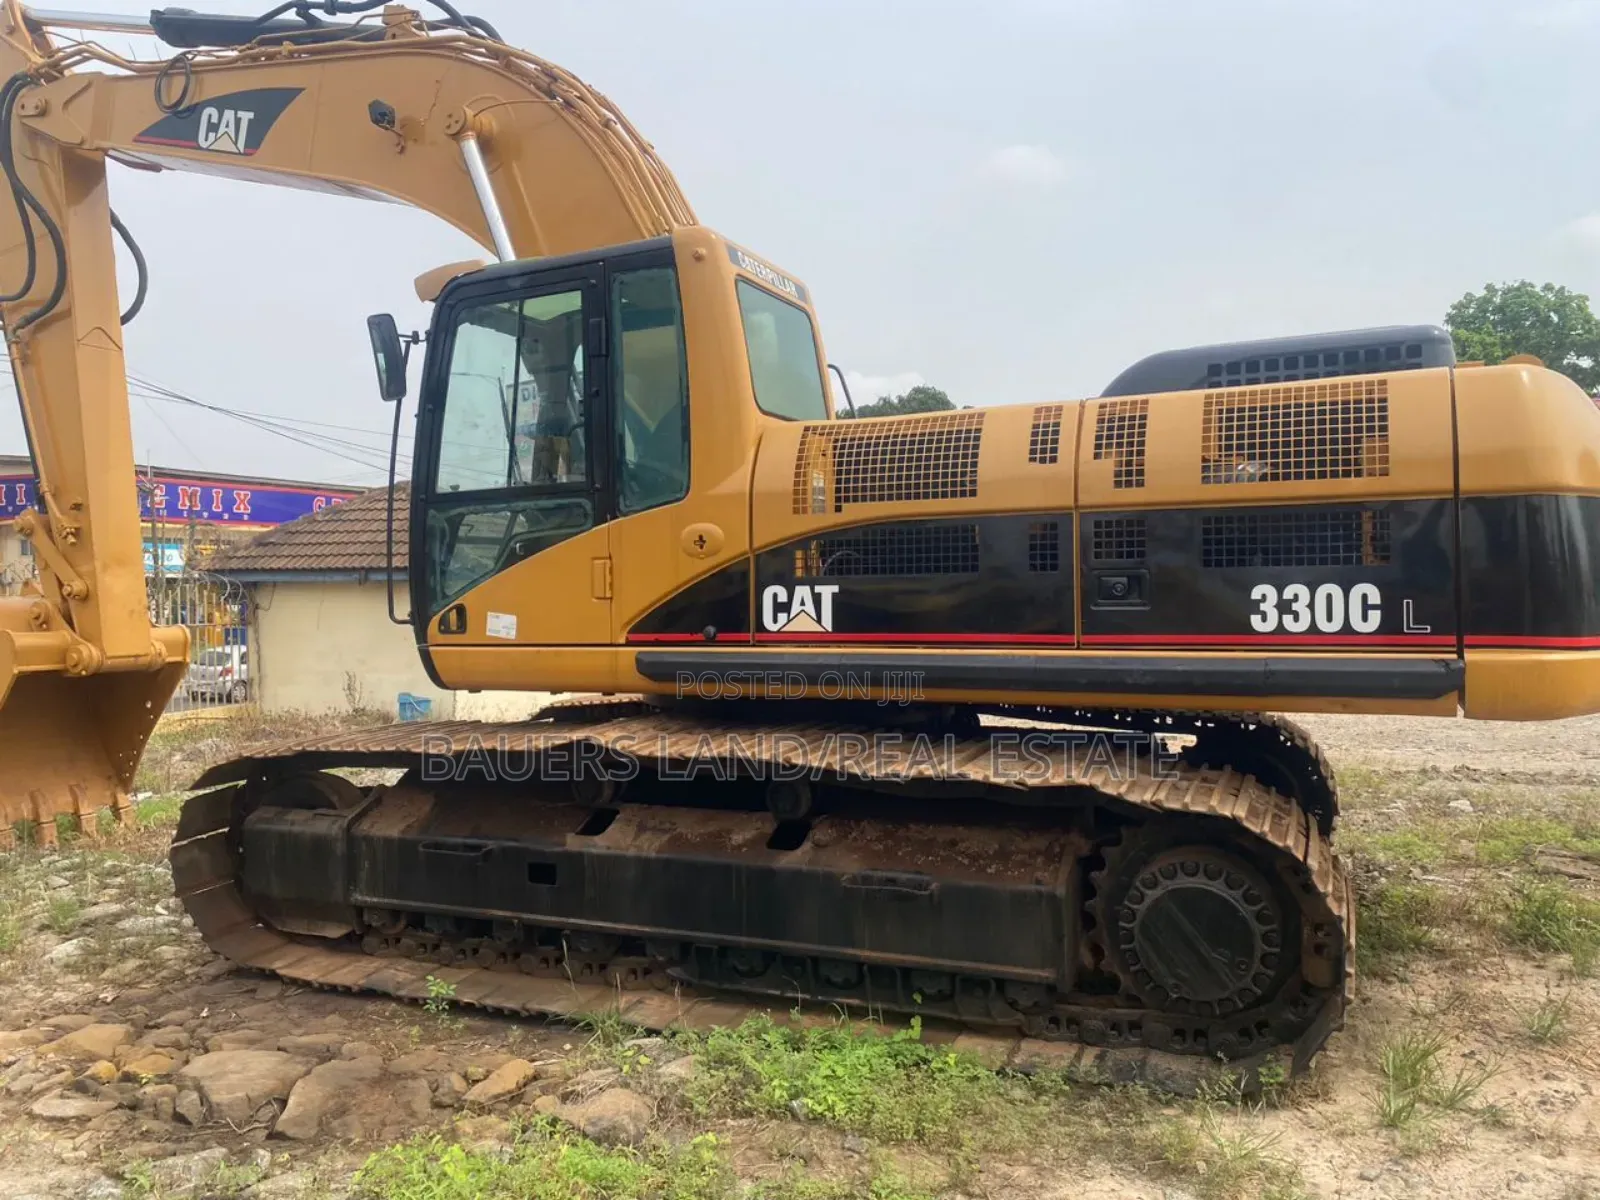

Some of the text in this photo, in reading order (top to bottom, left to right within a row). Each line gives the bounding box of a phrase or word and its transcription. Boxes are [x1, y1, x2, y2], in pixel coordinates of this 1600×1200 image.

[198, 106, 254, 154] CAT
[762, 584, 839, 632] CAT
[1250, 583, 1431, 633] 330C L
